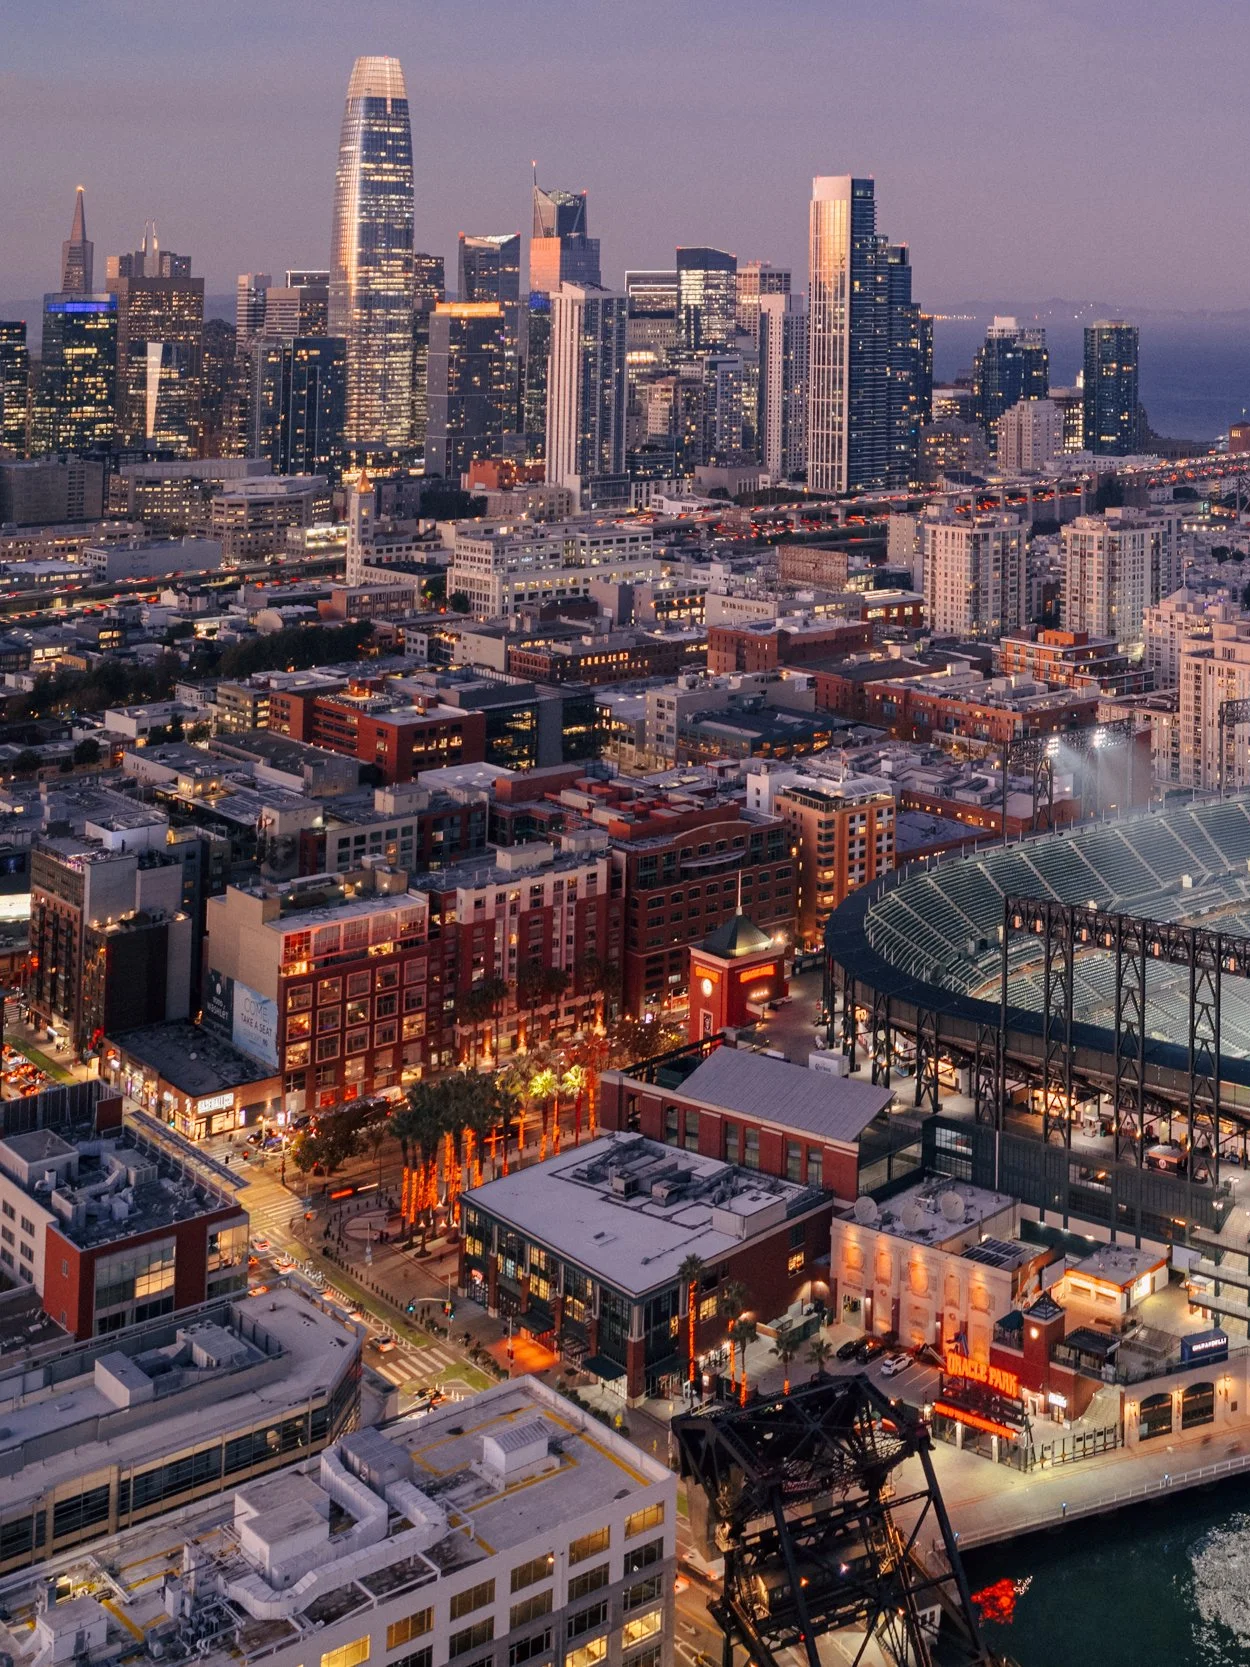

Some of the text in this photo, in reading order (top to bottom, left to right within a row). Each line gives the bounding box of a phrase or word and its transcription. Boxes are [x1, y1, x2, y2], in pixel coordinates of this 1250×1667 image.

[241, 1012, 254, 1028] TAKE
[259, 1023, 273, 1037] SEAT
[946, 1352, 1018, 1399] ORACLE PARK
